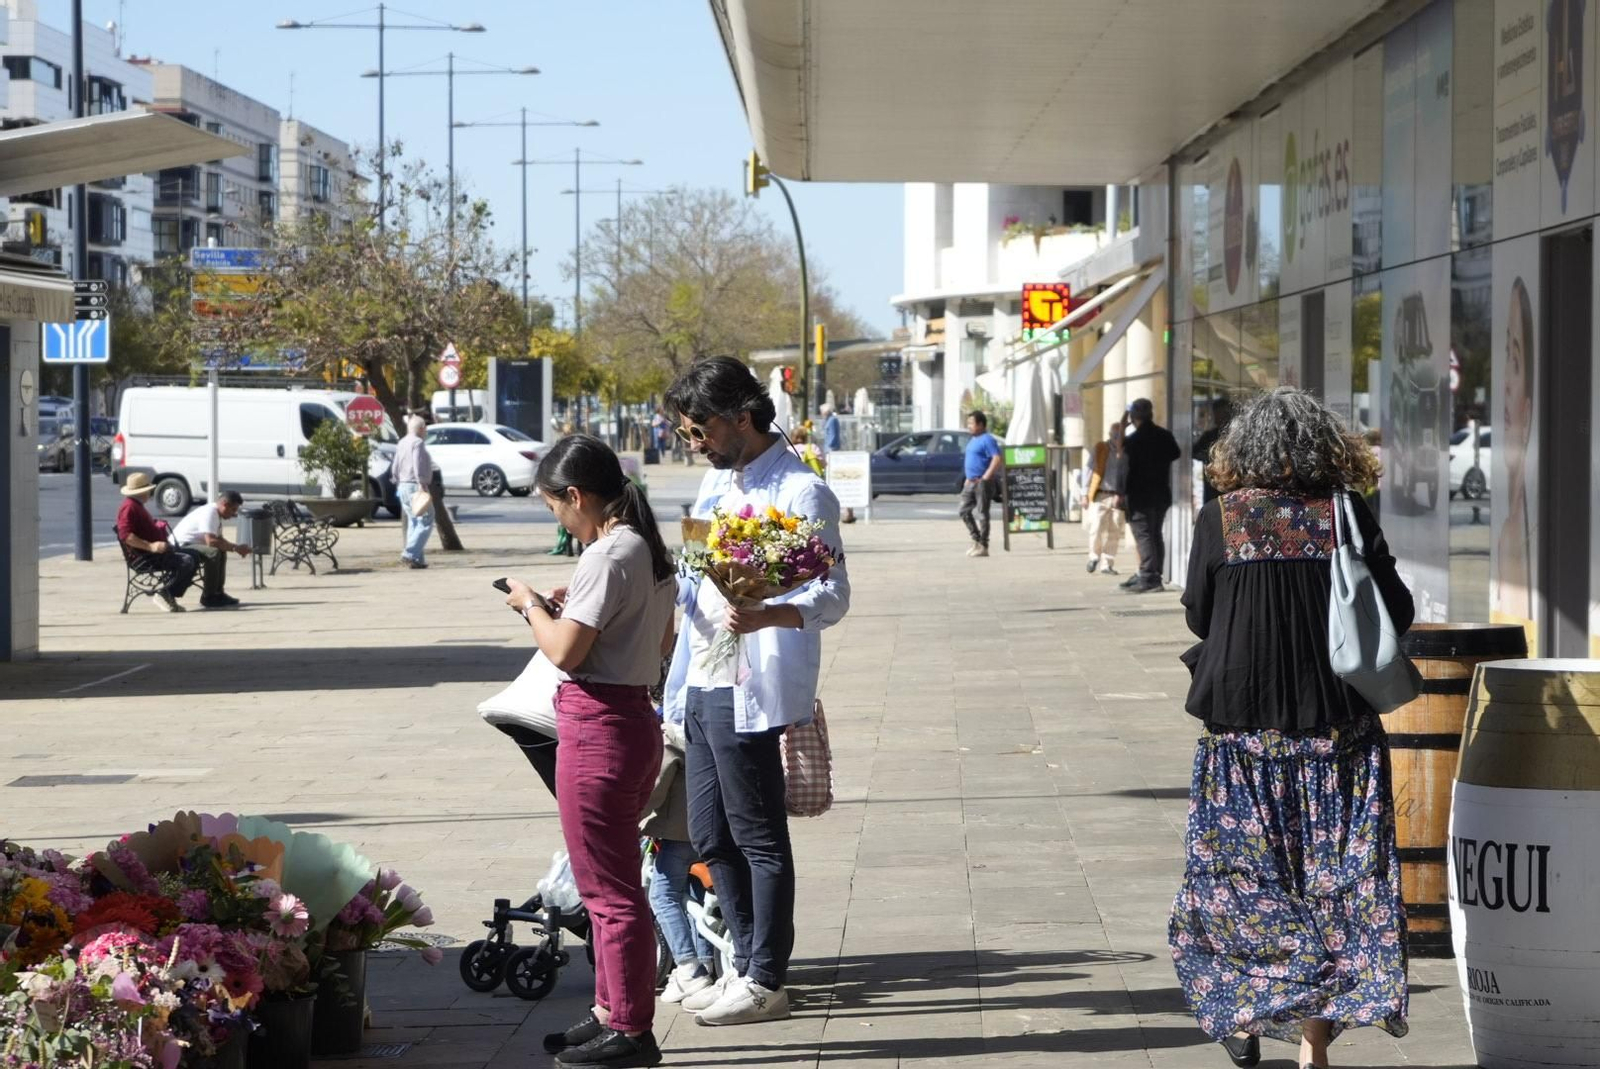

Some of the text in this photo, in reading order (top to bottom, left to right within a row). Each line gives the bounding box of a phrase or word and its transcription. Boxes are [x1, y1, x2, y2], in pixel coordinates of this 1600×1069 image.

[194, 250, 226, 260] Sevilla
[348, 409, 382, 421] STOP
[1467, 965, 1501, 995] RIOJA
[1505, 998, 1551, 1008] CALIFICADA
